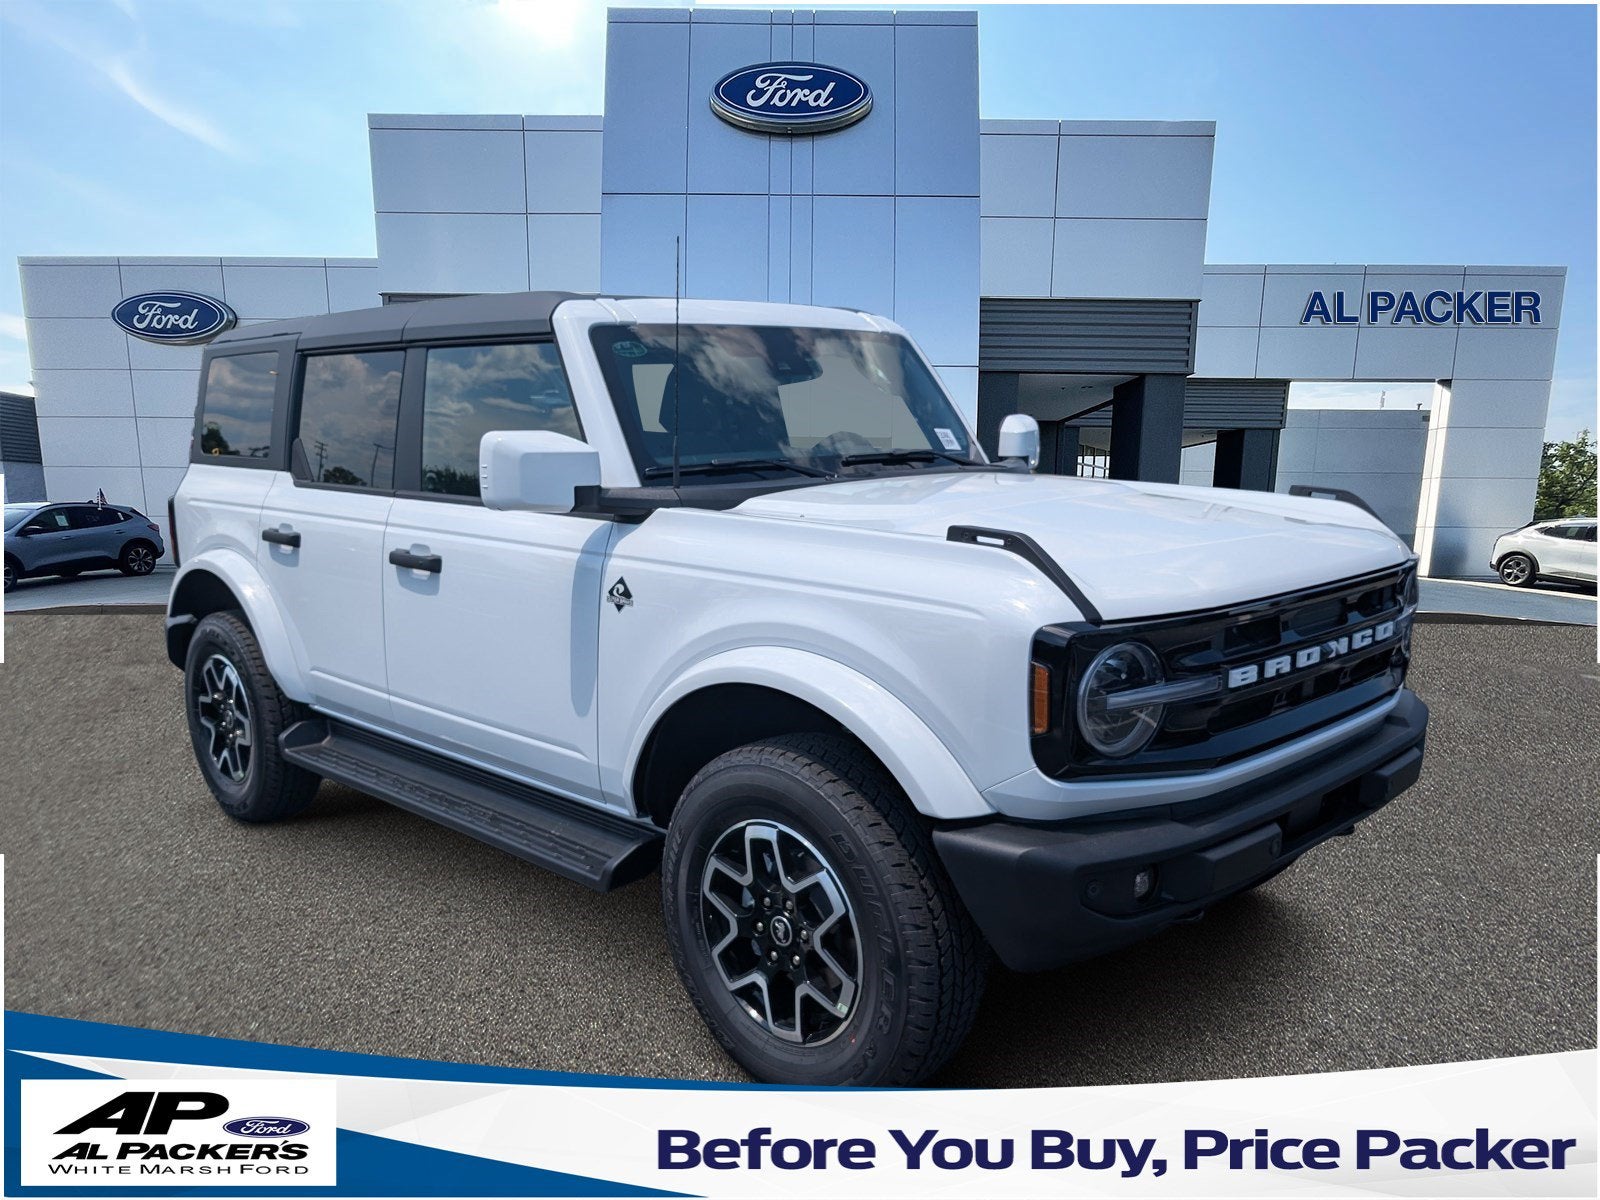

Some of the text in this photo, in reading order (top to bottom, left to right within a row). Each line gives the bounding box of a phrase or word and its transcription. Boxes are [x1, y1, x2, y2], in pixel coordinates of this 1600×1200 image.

[746, 73, 836, 107] Ford
[133, 301, 199, 329] Ford
[1301, 290, 1542, 324] AL PACKER
[1228, 621, 1394, 688] BRONCO
